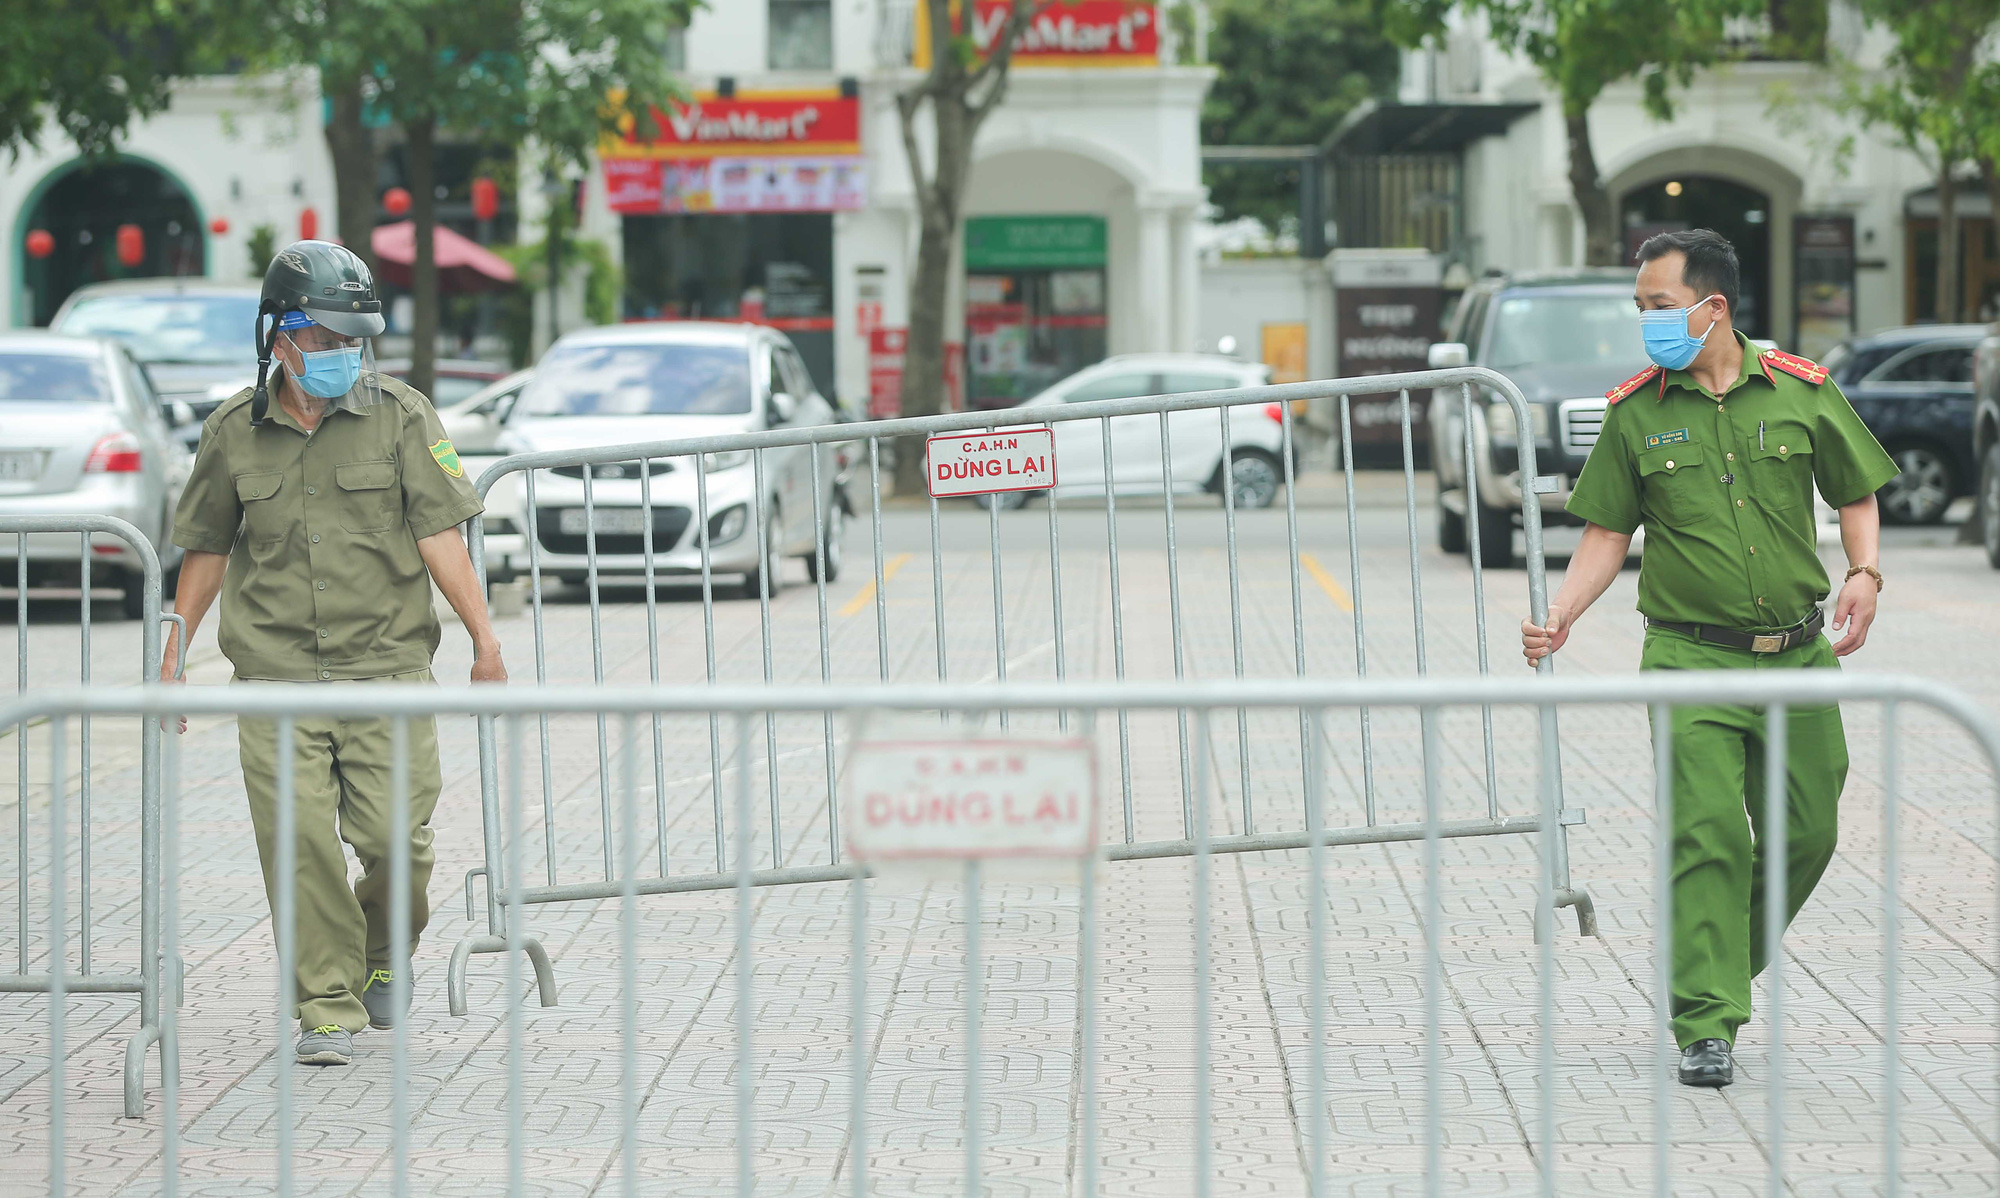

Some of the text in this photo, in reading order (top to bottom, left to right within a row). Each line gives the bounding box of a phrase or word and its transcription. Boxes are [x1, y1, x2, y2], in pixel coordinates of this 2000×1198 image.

[972, 7, 1149, 52] VnMart+
[962, 438, 1018, 453] C.A.H.N
[937, 455, 1045, 480] DỪNG LẠI
